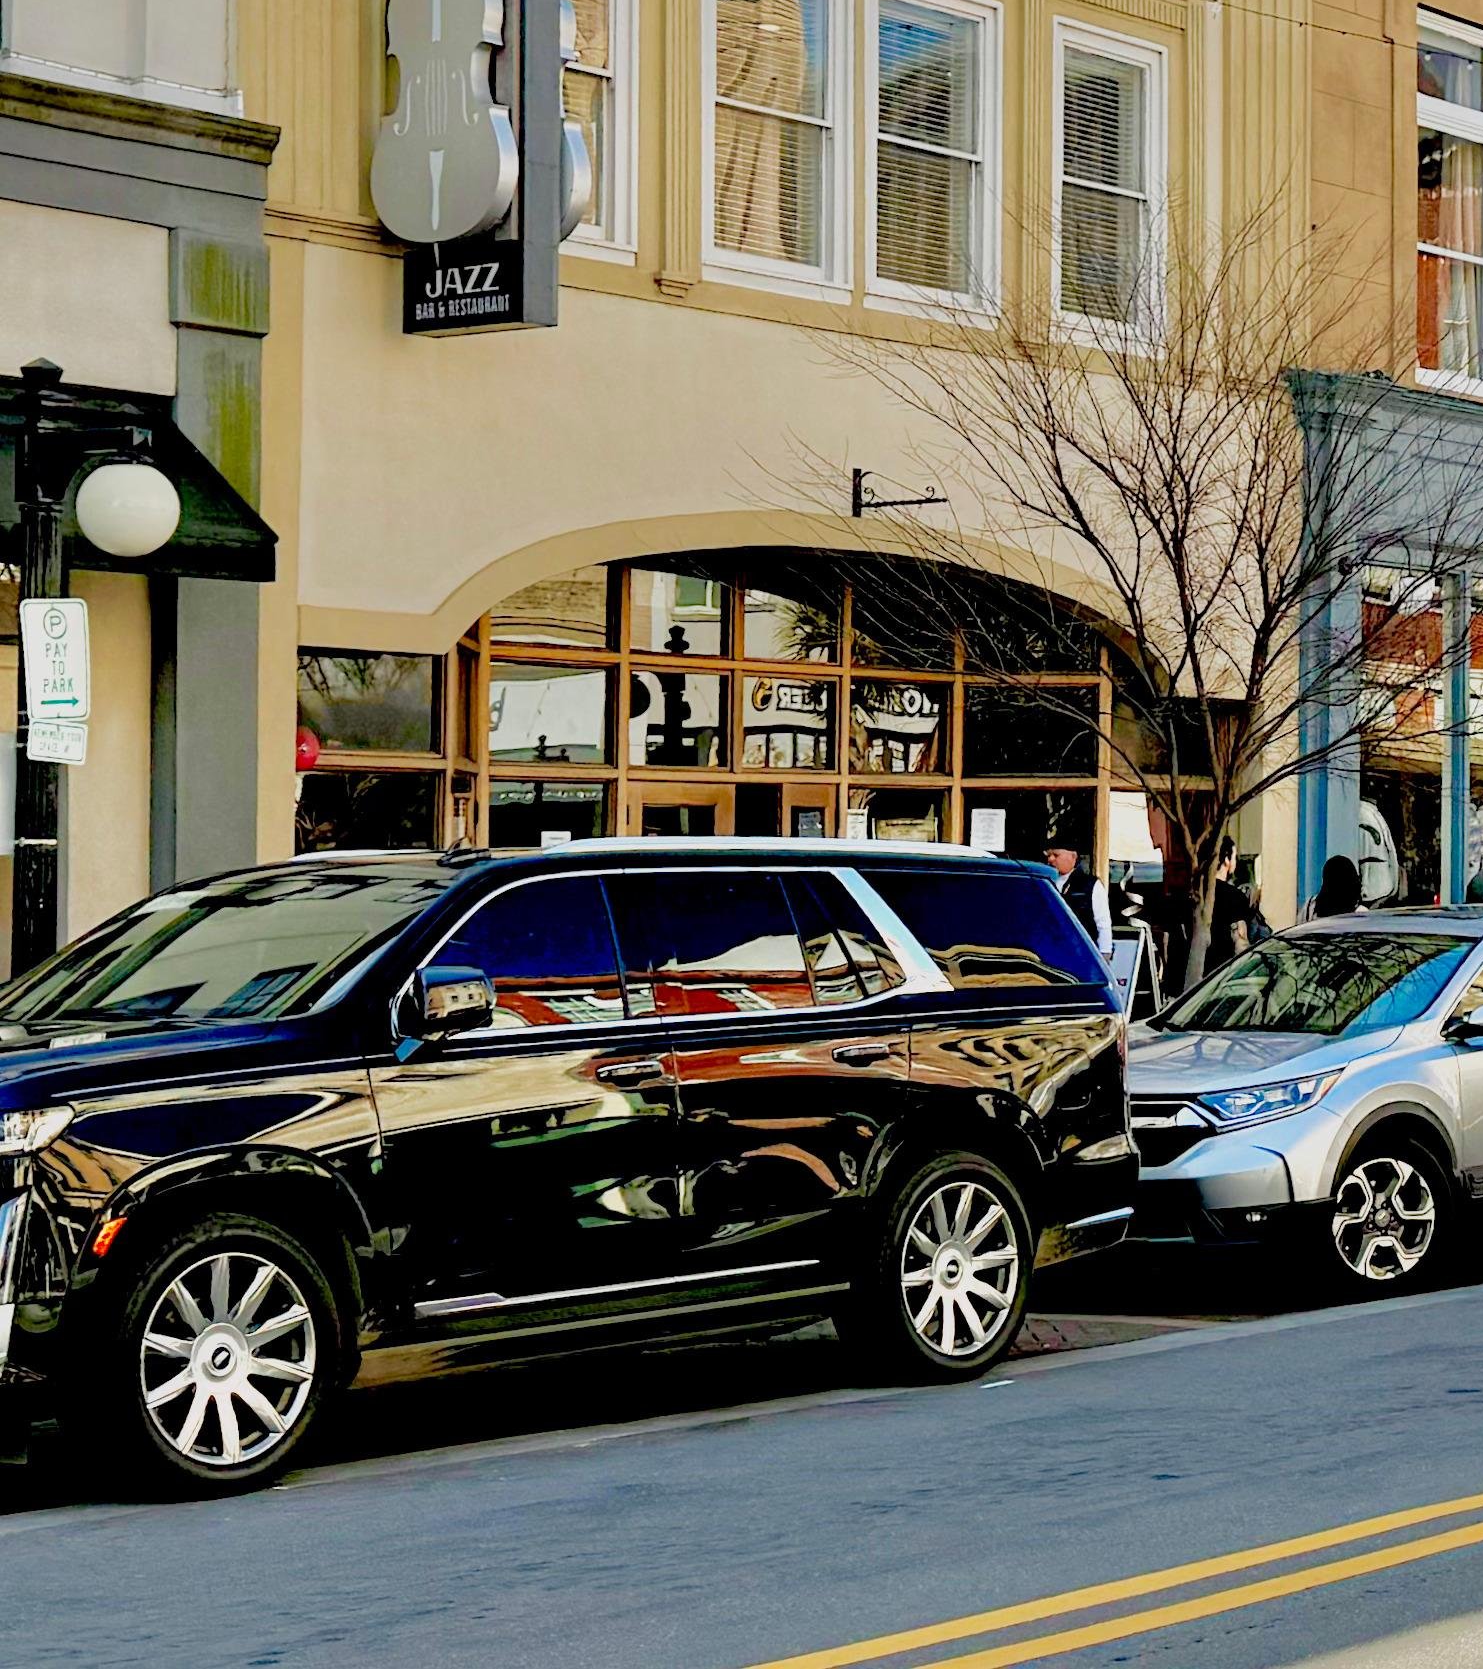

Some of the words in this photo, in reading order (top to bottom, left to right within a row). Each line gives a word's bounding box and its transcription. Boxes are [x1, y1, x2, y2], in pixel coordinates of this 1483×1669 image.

[425, 261, 500, 299] JAZZ
[415, 301, 436, 320] BAR
[438, 301, 446, 318] &
[448, 293, 511, 317] RESTAURANT
[44, 642, 68, 658] PAY
[51, 660, 65, 675] TO
[42, 677, 75, 693] PARK
